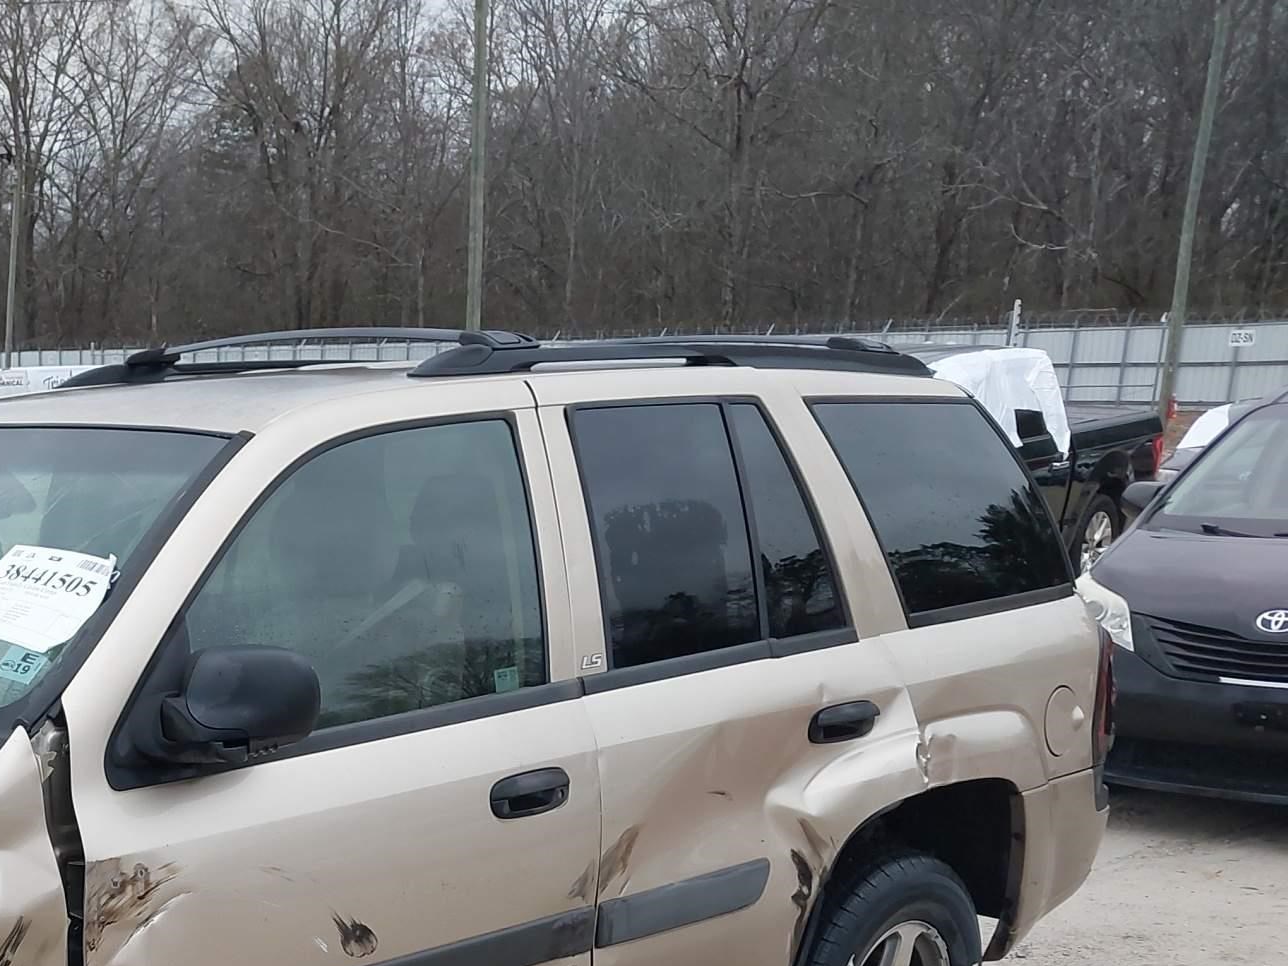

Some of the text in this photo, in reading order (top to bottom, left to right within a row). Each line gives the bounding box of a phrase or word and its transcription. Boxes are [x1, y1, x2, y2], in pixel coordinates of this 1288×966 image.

[21, 652, 40, 665] E
[580, 653, 603, 670] LS
[12, 663, 31, 675] 19
